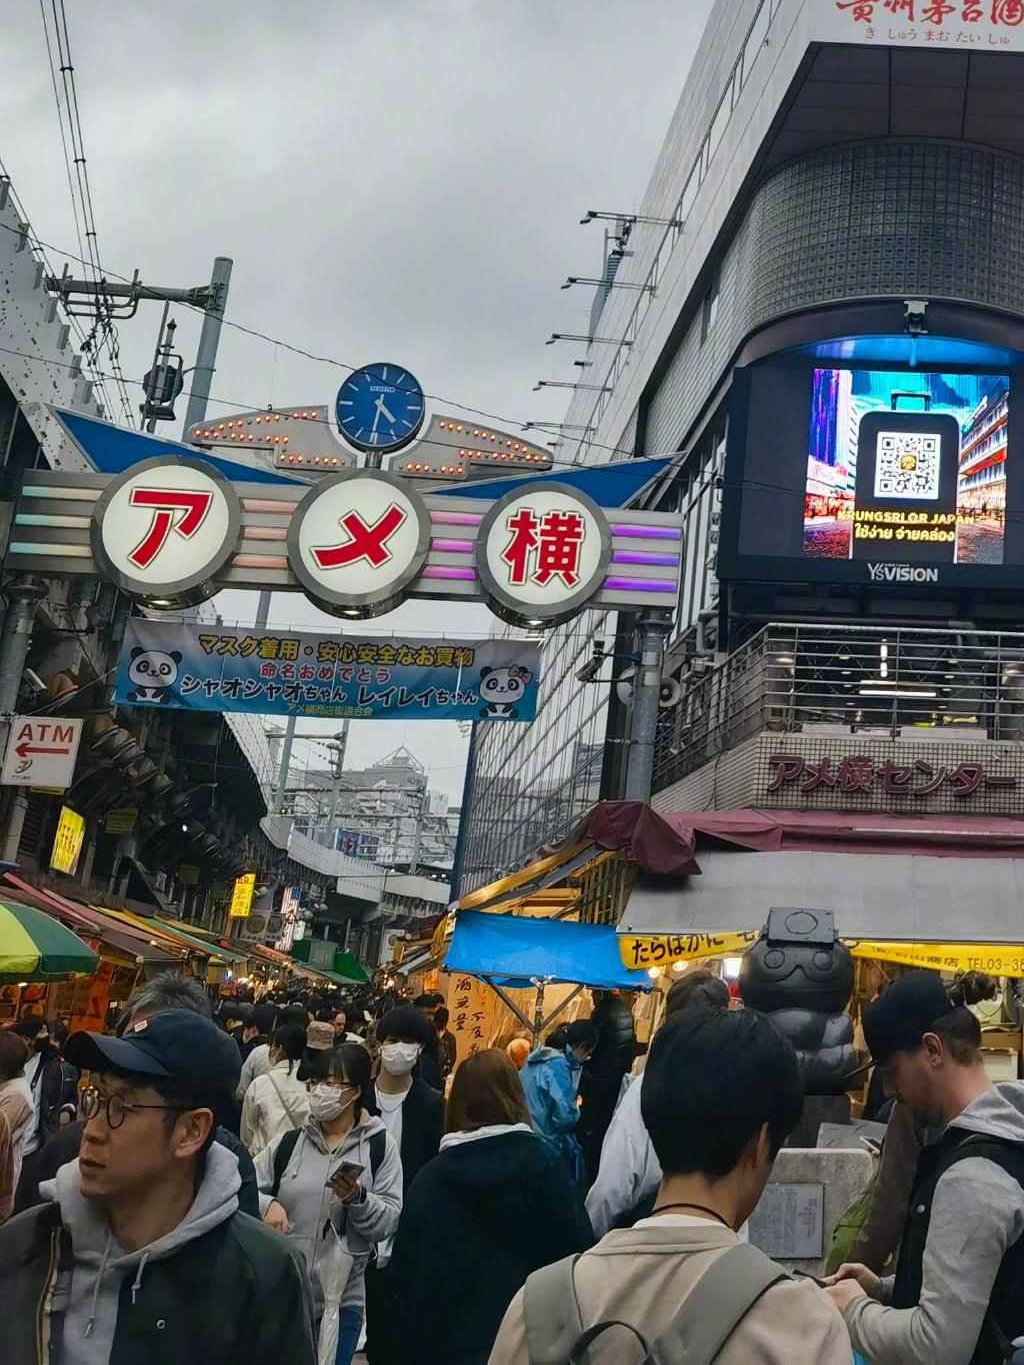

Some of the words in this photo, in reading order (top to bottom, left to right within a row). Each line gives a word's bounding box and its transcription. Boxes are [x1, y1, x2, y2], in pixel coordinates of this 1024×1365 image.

[369, 385, 397, 393] SEIKO
[930, 514, 975, 526] JAPAN
[127, 487, 586, 591] アメ横
[198, 634, 475, 668] マスク着用・安心安全なお買物
[259, 662, 391, 683] 命名おめでとう
[179, 674, 347, 703] シャオシャオちゃん
[357, 683, 478, 707] レイレイちゃん
[17, 724, 75, 743] ATM
[767, 754, 1017, 796] アメ横センター
